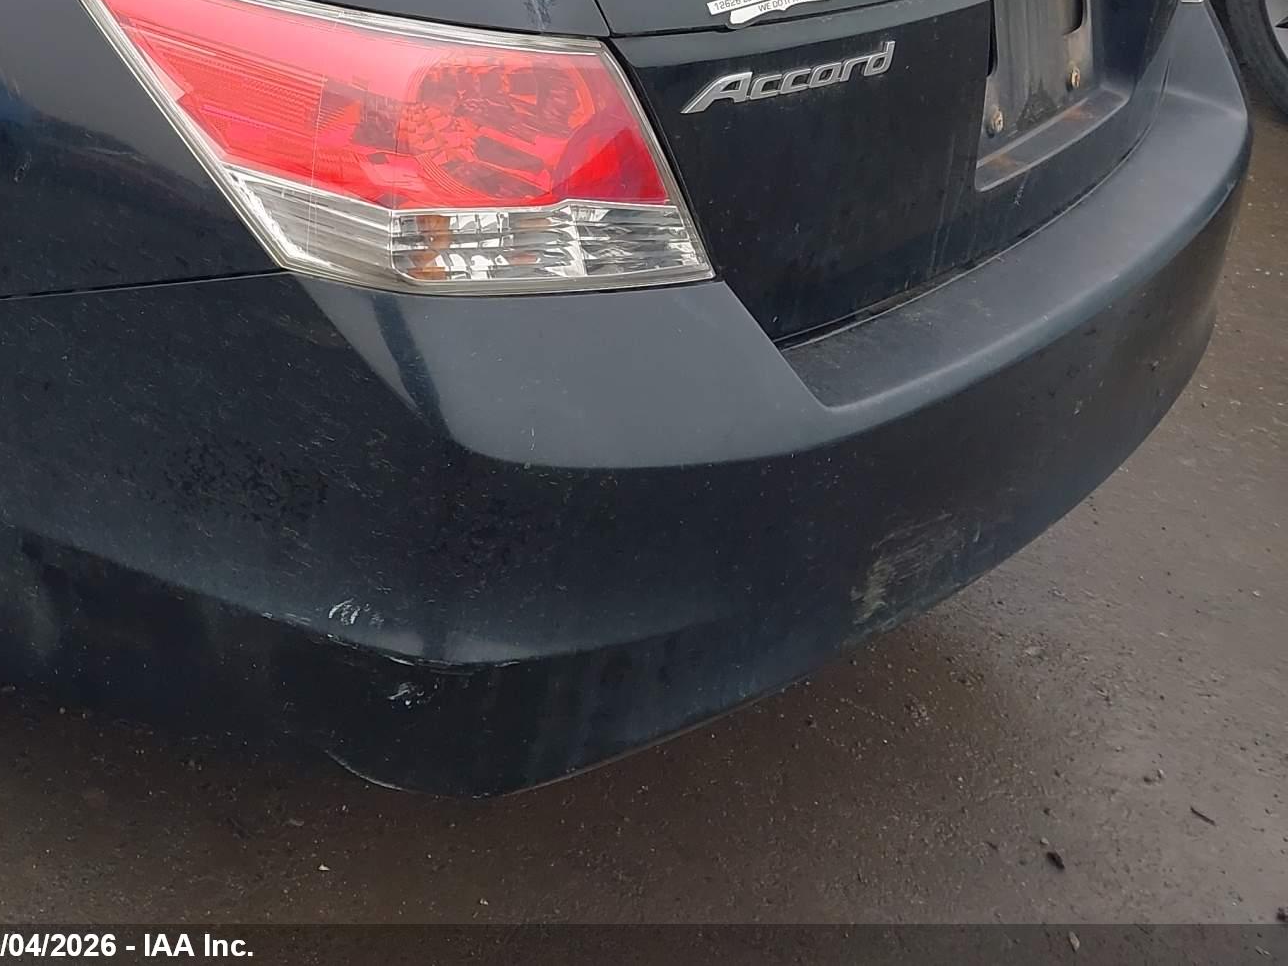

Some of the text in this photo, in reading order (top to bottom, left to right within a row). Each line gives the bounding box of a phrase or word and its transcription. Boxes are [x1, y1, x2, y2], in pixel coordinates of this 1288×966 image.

[758, 2, 772, 12] WE
[772, 0, 784, 9] DO
[680, 40, 896, 115] Accord
